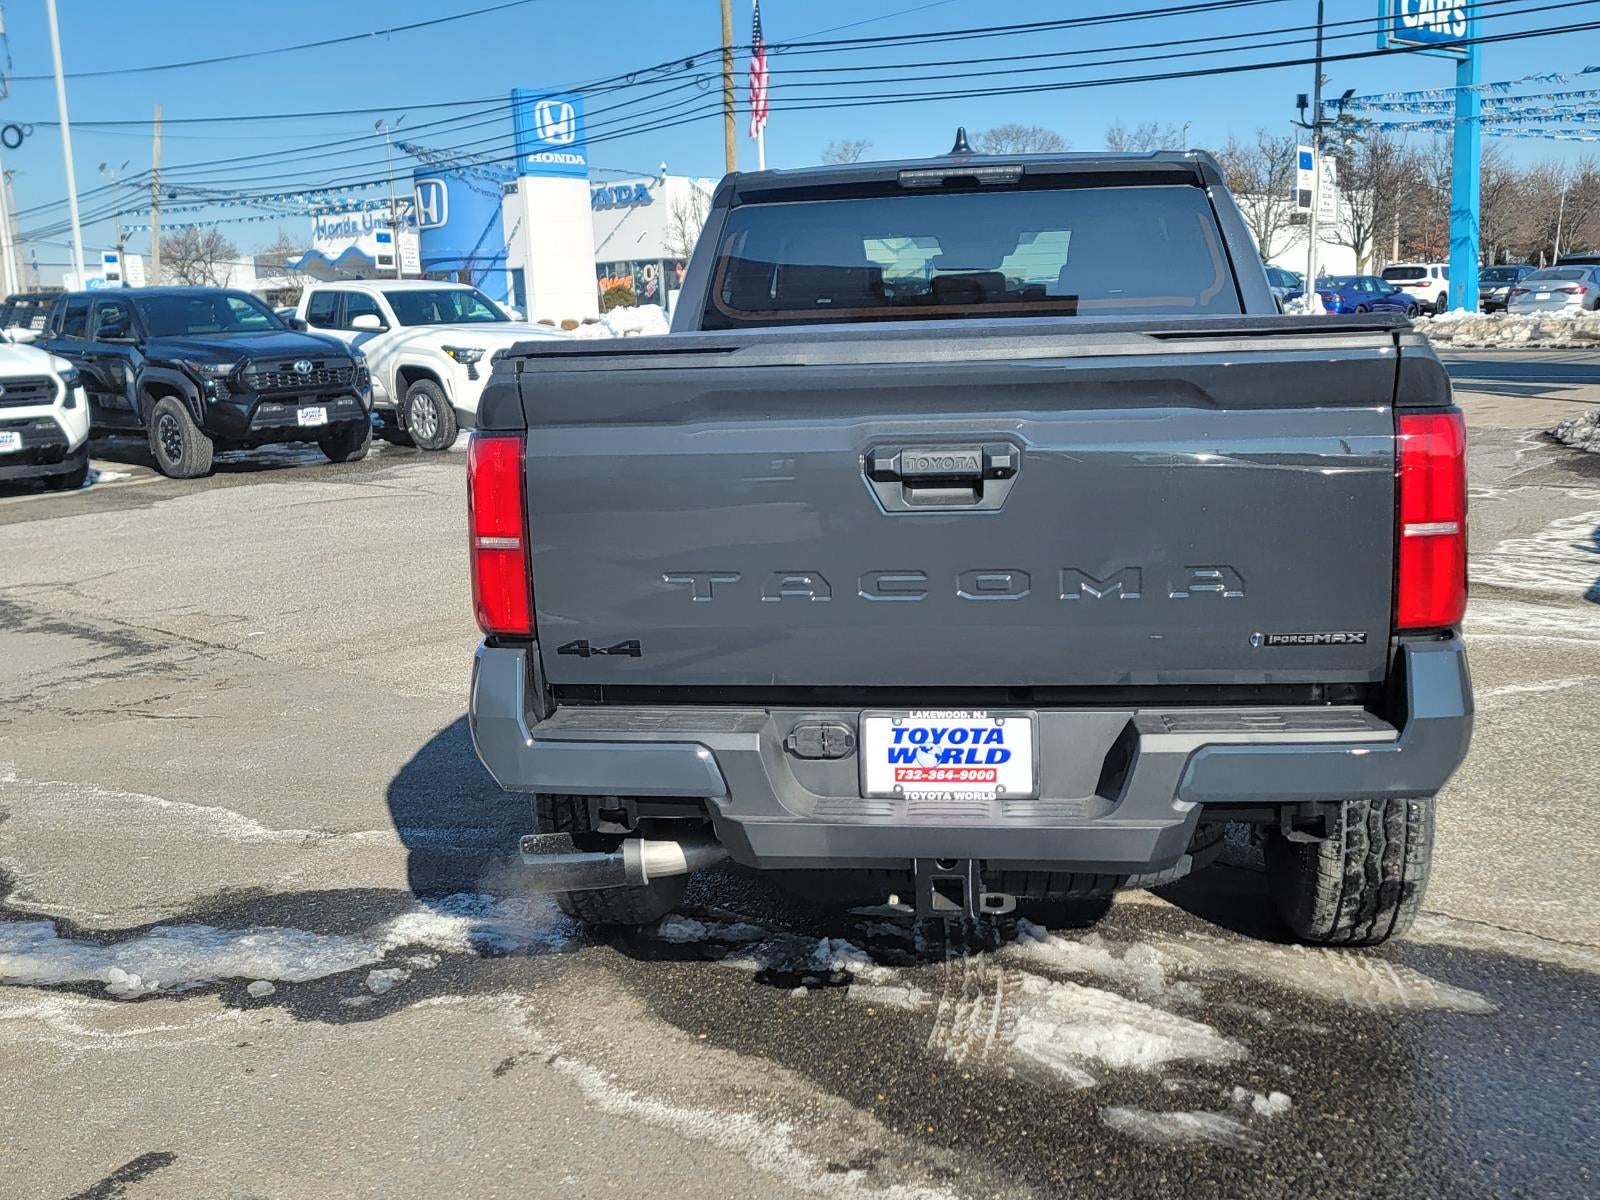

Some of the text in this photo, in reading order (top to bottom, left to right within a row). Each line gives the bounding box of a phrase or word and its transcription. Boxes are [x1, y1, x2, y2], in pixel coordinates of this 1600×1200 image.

[1401, 0, 1467, 37] CARS
[528, 152, 586, 165] HONDA
[316, 212, 360, 240] Honda
[905, 456, 979, 470] TOYOTA
[661, 564, 1246, 601] TACOMA
[972, 711, 987, 719] NJ
[891, 728, 1004, 745] TOYOTA
[897, 769, 995, 780] 732-364-9000
[903, 792, 996, 800] TOYOTA WORLD
